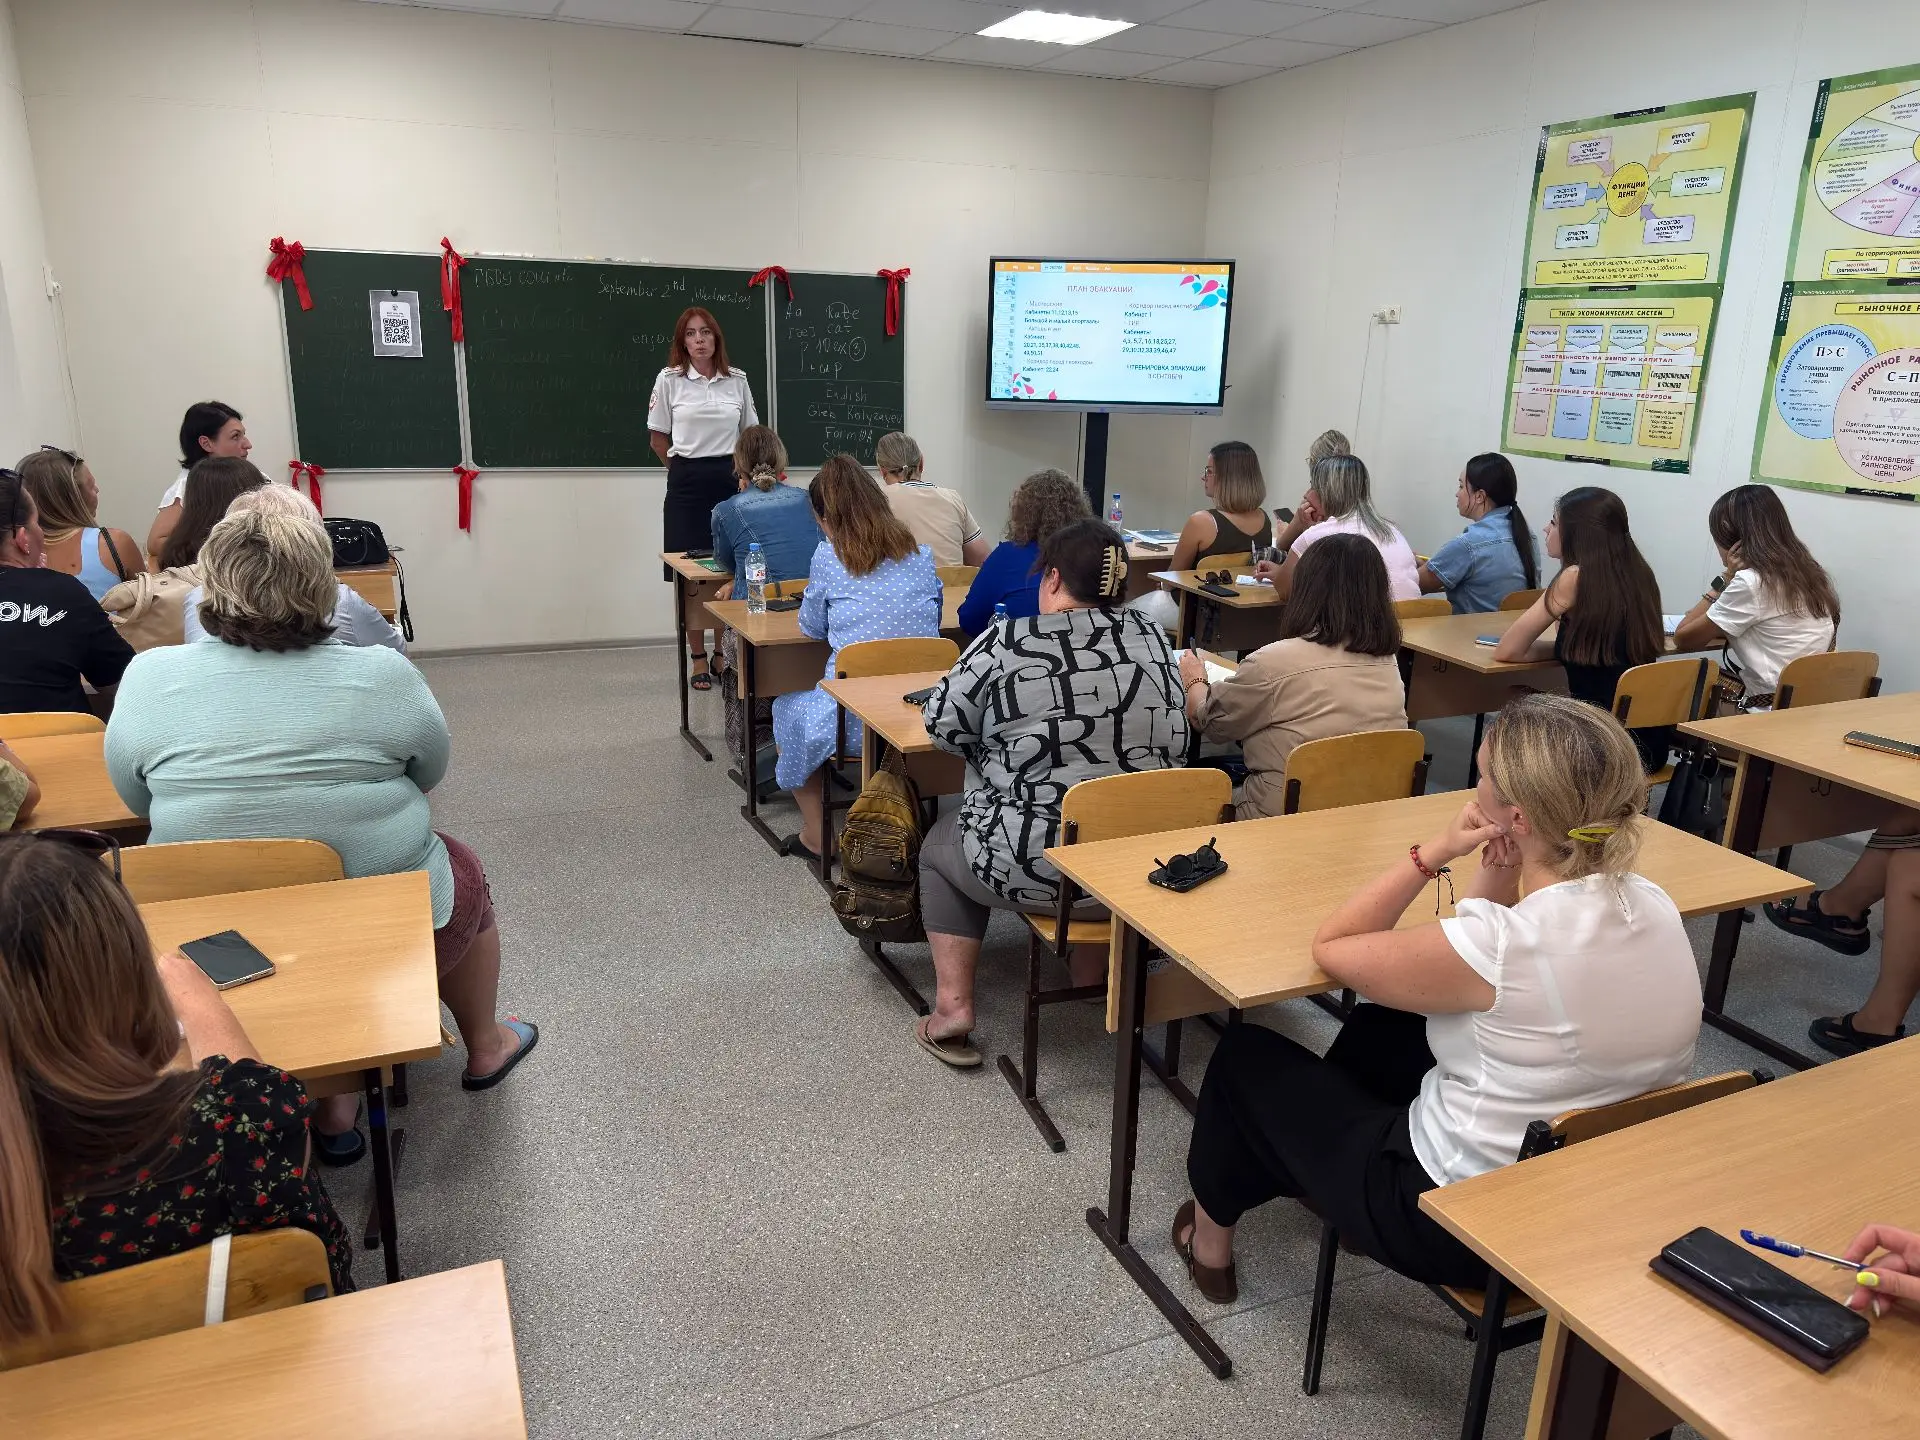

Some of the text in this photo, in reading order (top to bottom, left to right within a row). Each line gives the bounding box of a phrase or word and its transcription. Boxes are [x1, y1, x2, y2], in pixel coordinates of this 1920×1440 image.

[1612, 181, 1646, 190] ФУНКЦИИ
[1618, 190, 1637, 198] ДЕНЕГ
[660, 276, 686, 298] 2nd
[1858, 304, 1912, 312] РЫНОЧНОЕ
[1780, 330, 1872, 384] ПРЕДЛОЖЕНИЕ ПРЕВЫШАЕТ СПРОС
[1850, 356, 1900, 392] РЫНОЧНОЕ
[1582, 390, 1633, 398] ОГРАНИЧЕННЫХ
[1861, 455, 1914, 464] УСТАНОВЛЕНИЕ
[1861, 462, 1912, 472] РАВНОВЕСНОЙ
